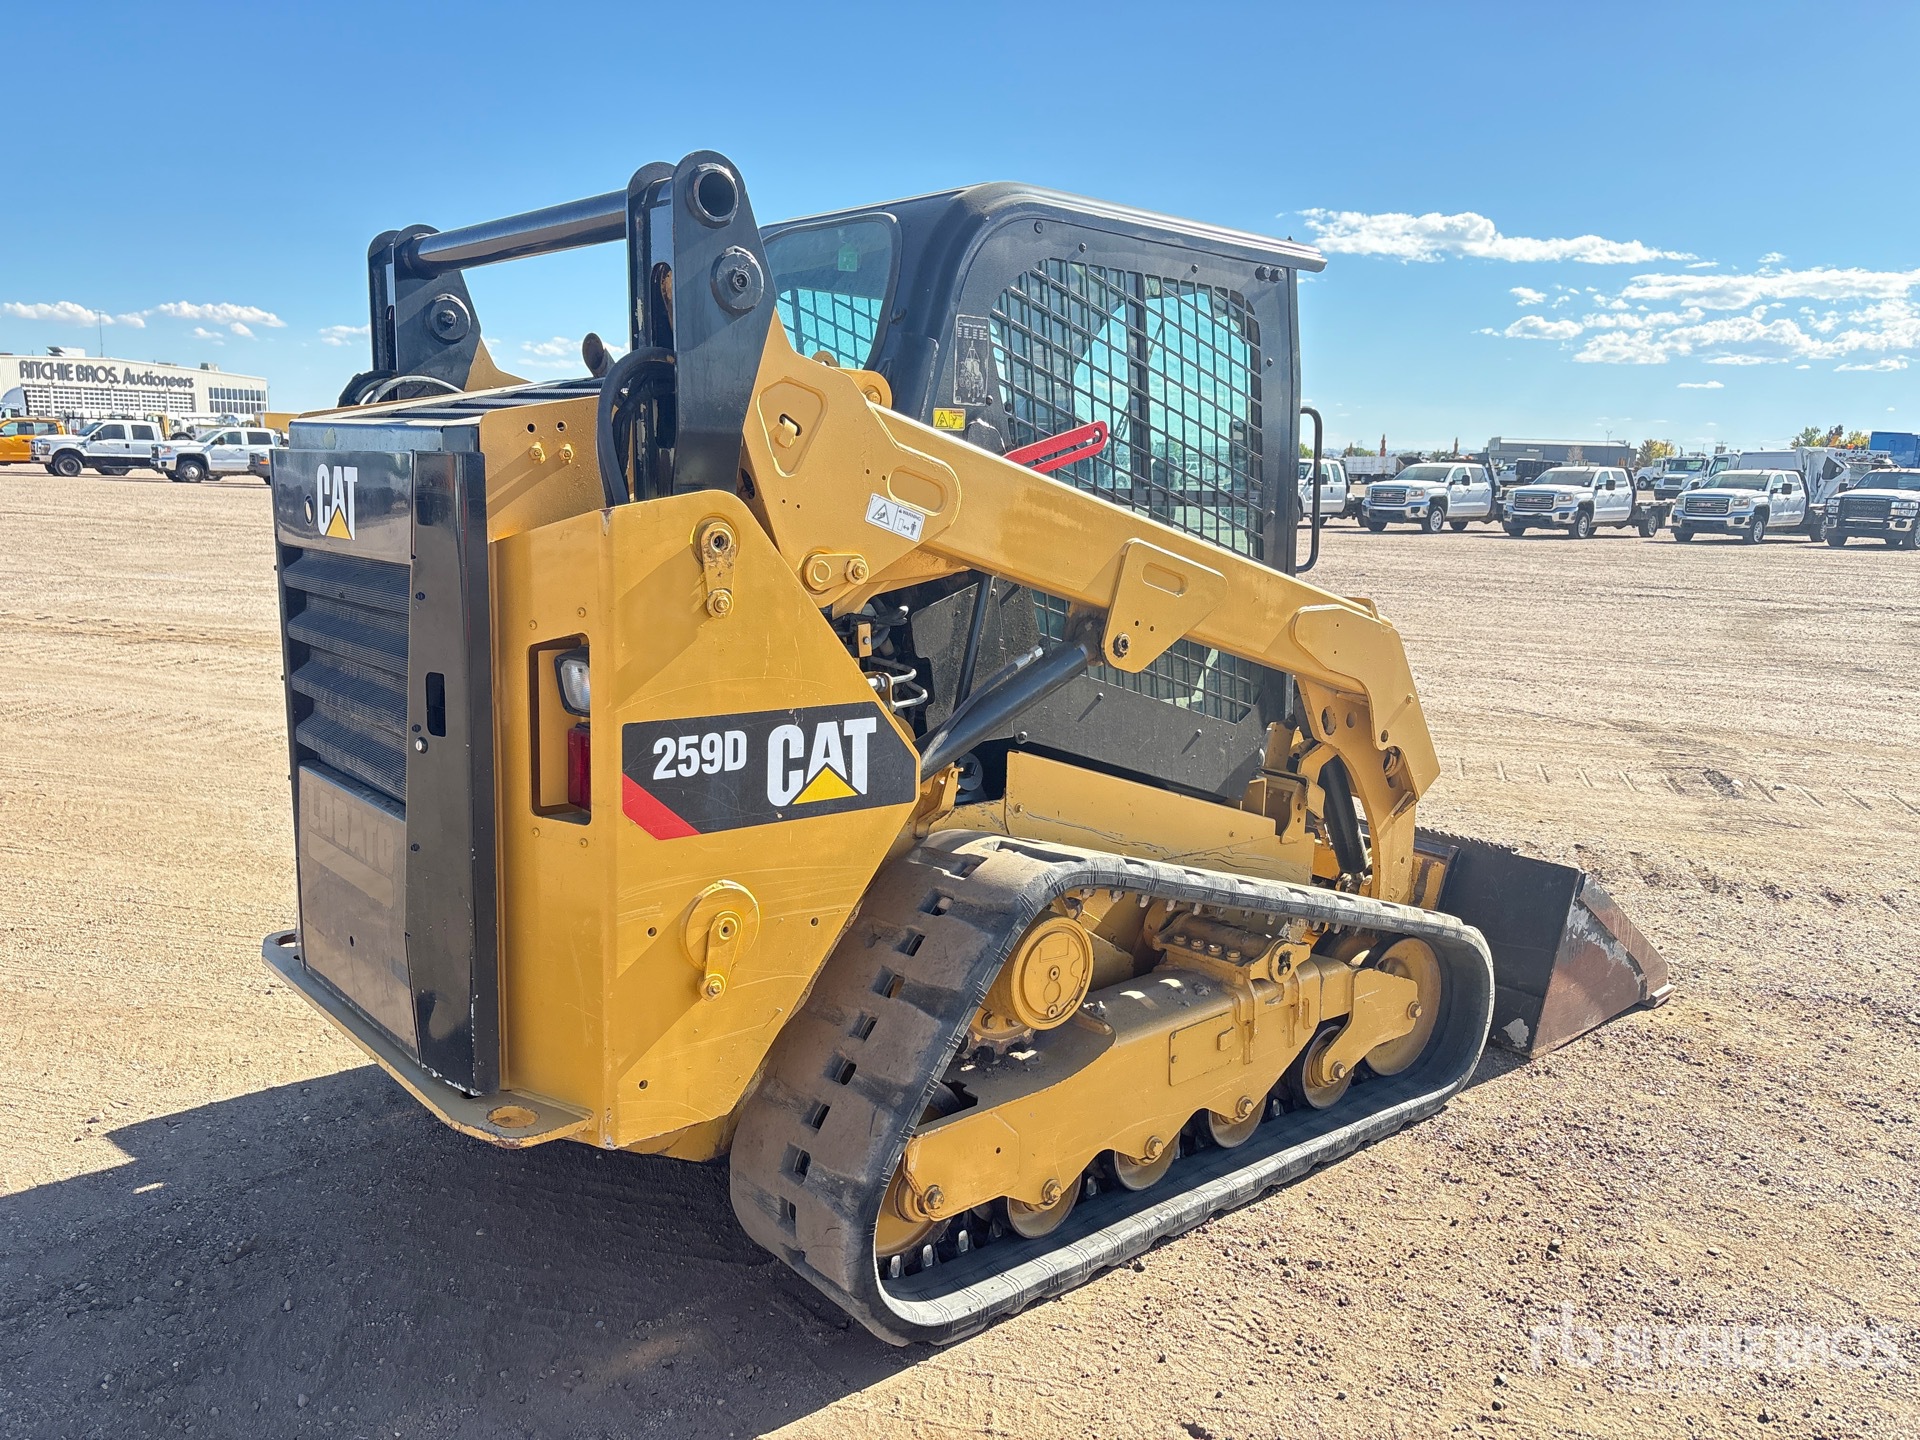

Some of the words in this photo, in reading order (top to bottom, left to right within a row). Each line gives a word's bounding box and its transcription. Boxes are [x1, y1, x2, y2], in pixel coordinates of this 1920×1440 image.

[19, 360, 74, 381] RITCHIE
[76, 364, 121, 385] BROS.
[123, 367, 195, 389] Auctioneers
[316, 463, 358, 541] CAT
[652, 730, 747, 781] 259D
[767, 717, 877, 807] CAT
[307, 784, 394, 876] LOBATO
